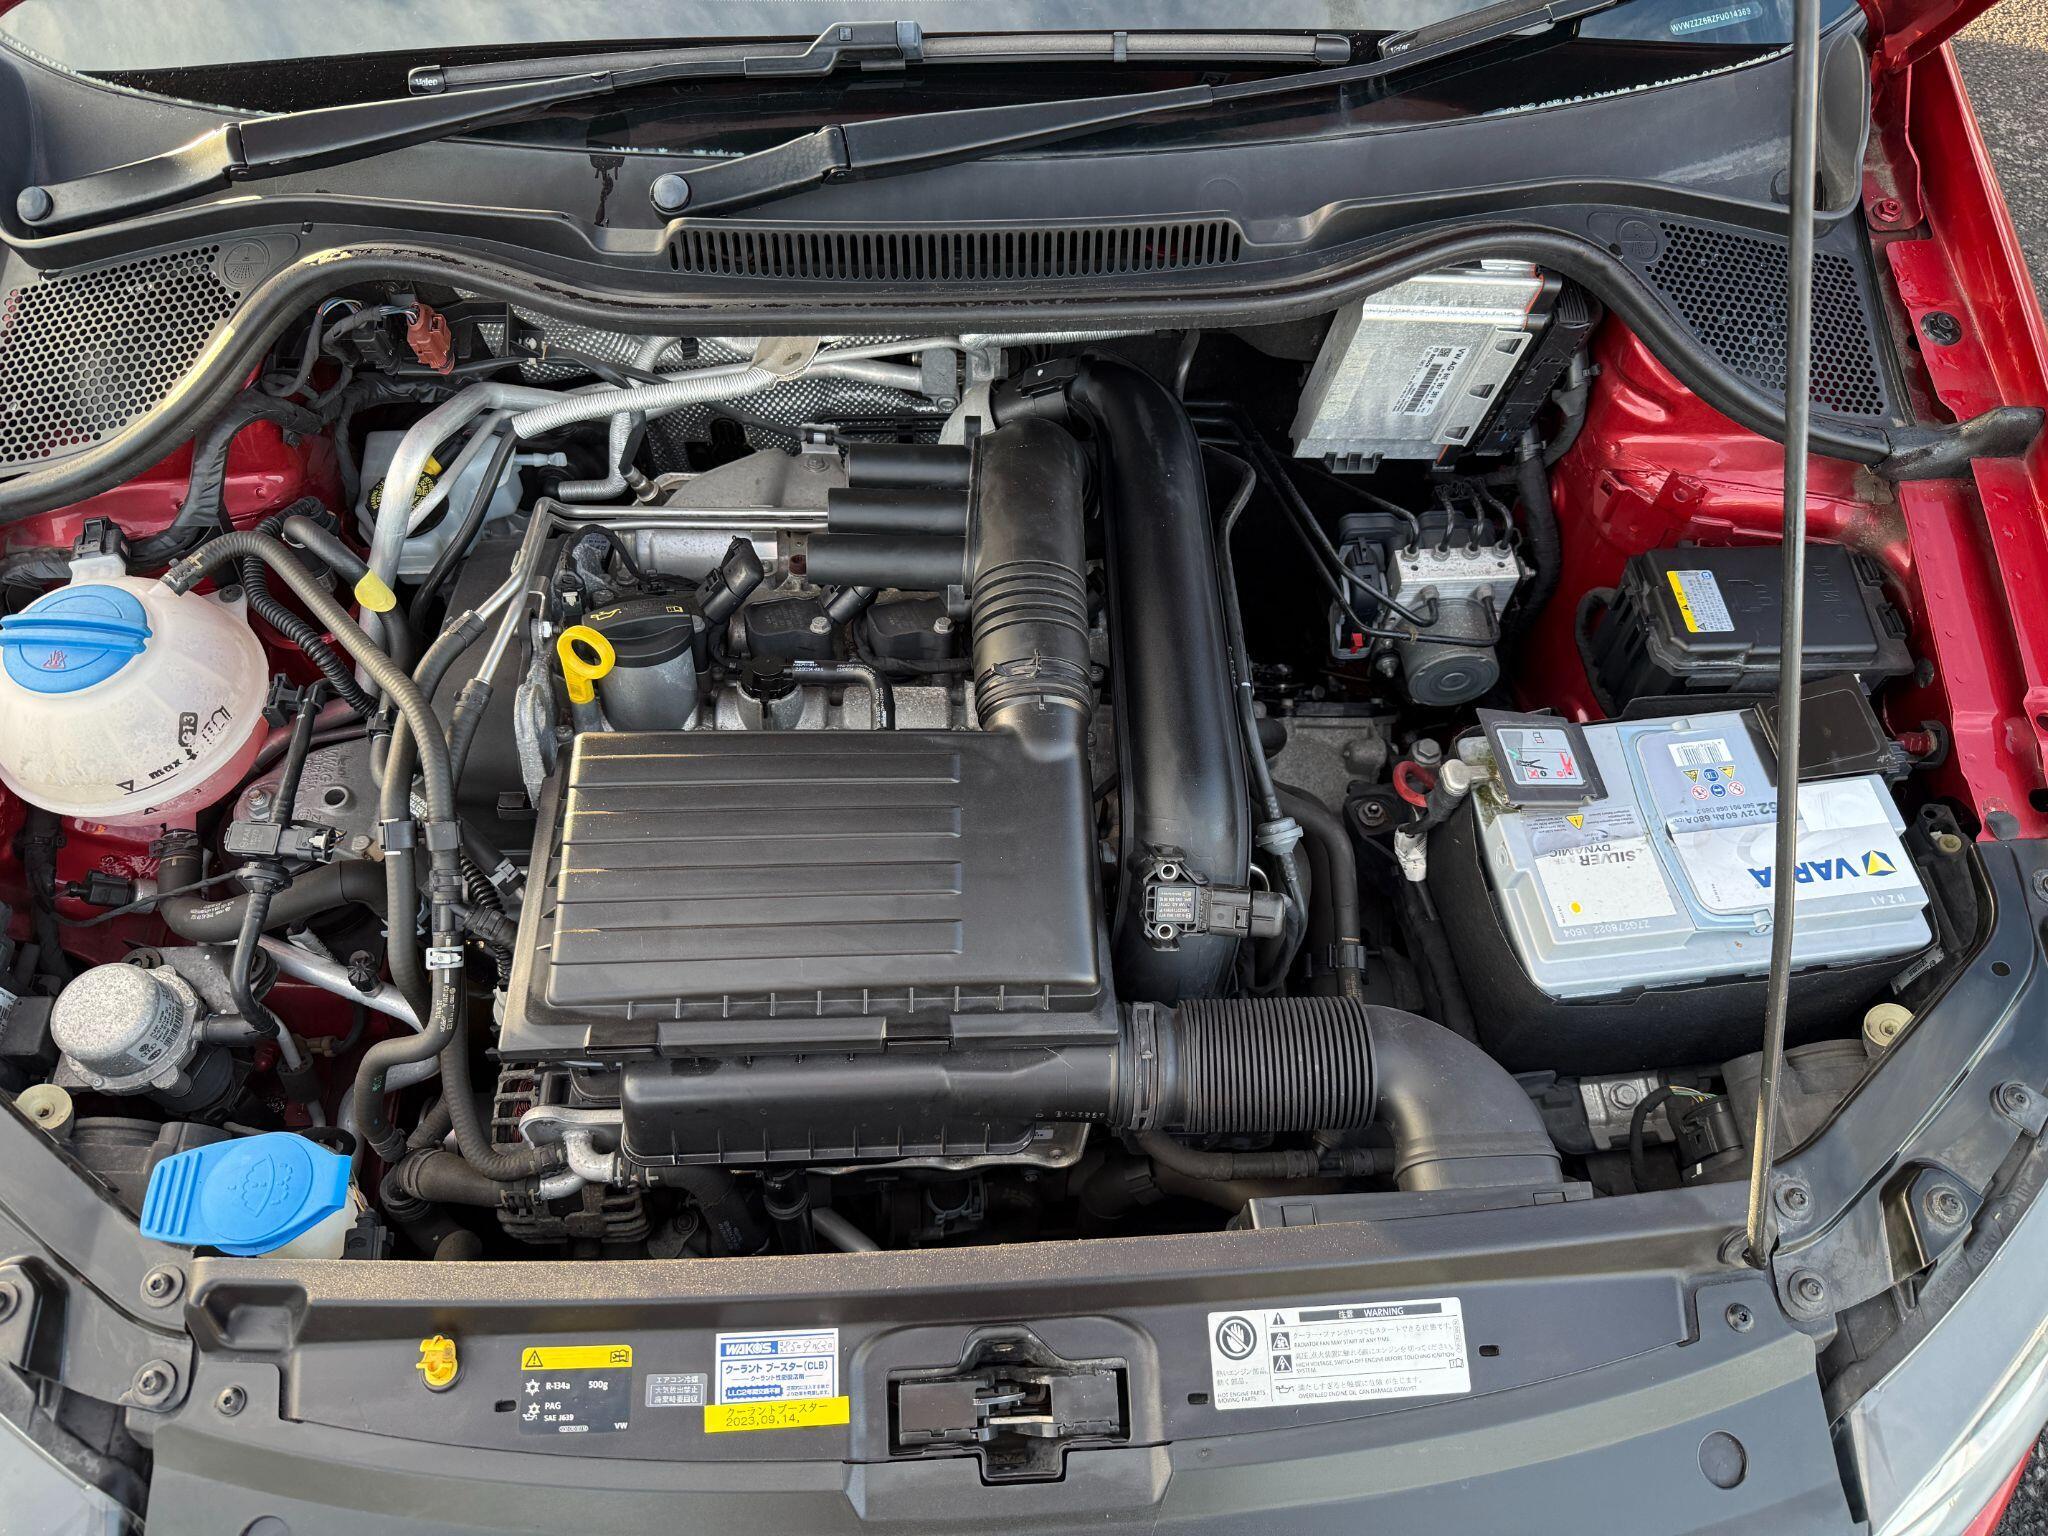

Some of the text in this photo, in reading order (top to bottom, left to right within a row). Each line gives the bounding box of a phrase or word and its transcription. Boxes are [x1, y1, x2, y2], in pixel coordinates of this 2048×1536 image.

[415, 77, 438, 87] Valeo
[181, 715, 196, 745] G13
[148, 758, 183, 780] max
[1684, 813, 1711, 824] 680A
[1713, 812, 1738, 822] 60Ah
[1741, 808, 1760, 819] 12V
[1549, 843, 1611, 858] DYNAMIC
[1580, 850, 1637, 867] SILVER
[1747, 857, 1860, 888] VARA
[1364, 1306, 1404, 1317] WARNING
[1404, 1353, 1431, 1361] TOUCHING
[725, 1363, 763, 1375] クーラント
[655, 1375, 699, 1384] エアコン冷媒
[545, 1380, 609, 1391] R-134a 500g
[544, 1402, 562, 1410] PAG
[726, 1402, 829, 1417] クーラントブースター
[543, 1413, 574, 1422] SAE J639
[614, 1422, 628, 1430] VW
